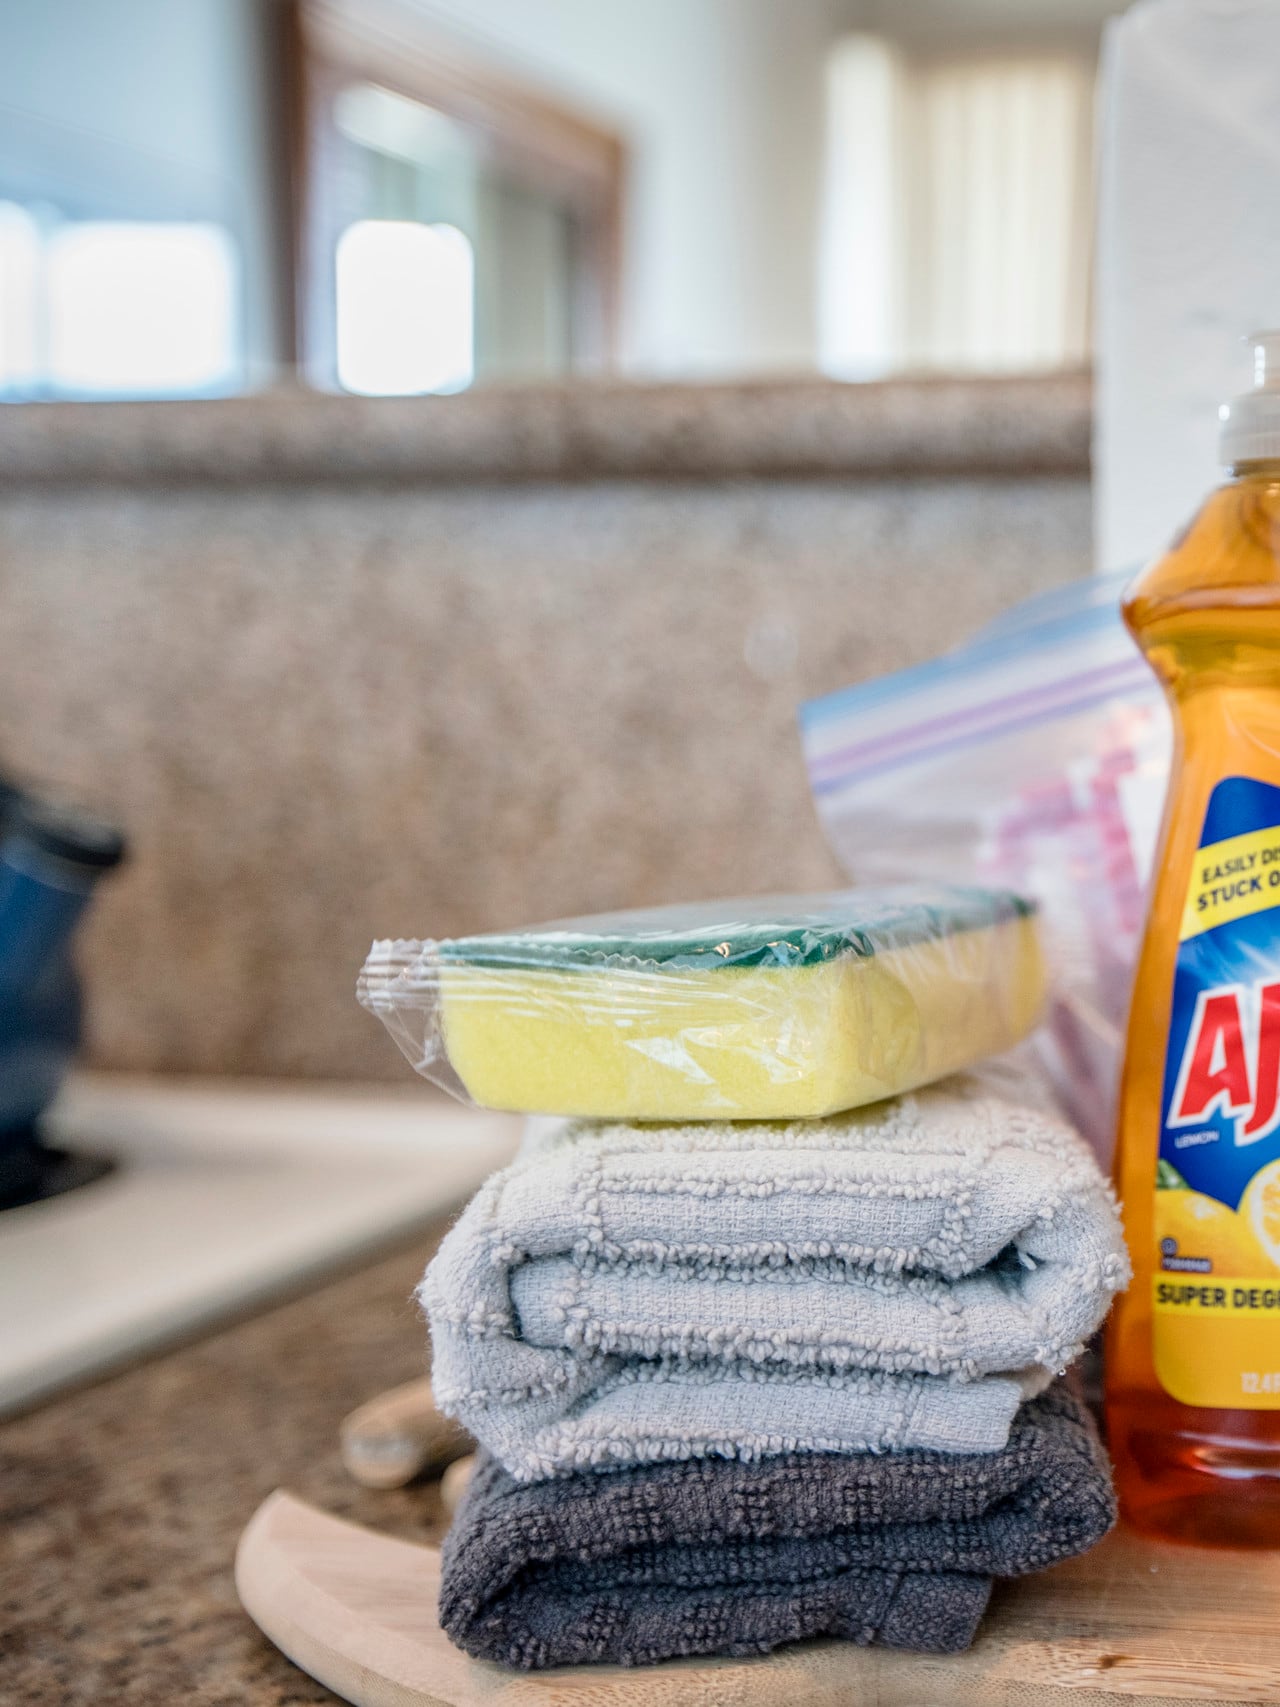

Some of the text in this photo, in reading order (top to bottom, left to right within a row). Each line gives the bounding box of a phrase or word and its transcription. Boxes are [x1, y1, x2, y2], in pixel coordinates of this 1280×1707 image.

[1202, 855, 1257, 884] EASILY
[1197, 877, 1263, 913] STUCK
[1157, 1284, 1227, 1309] SUPER
